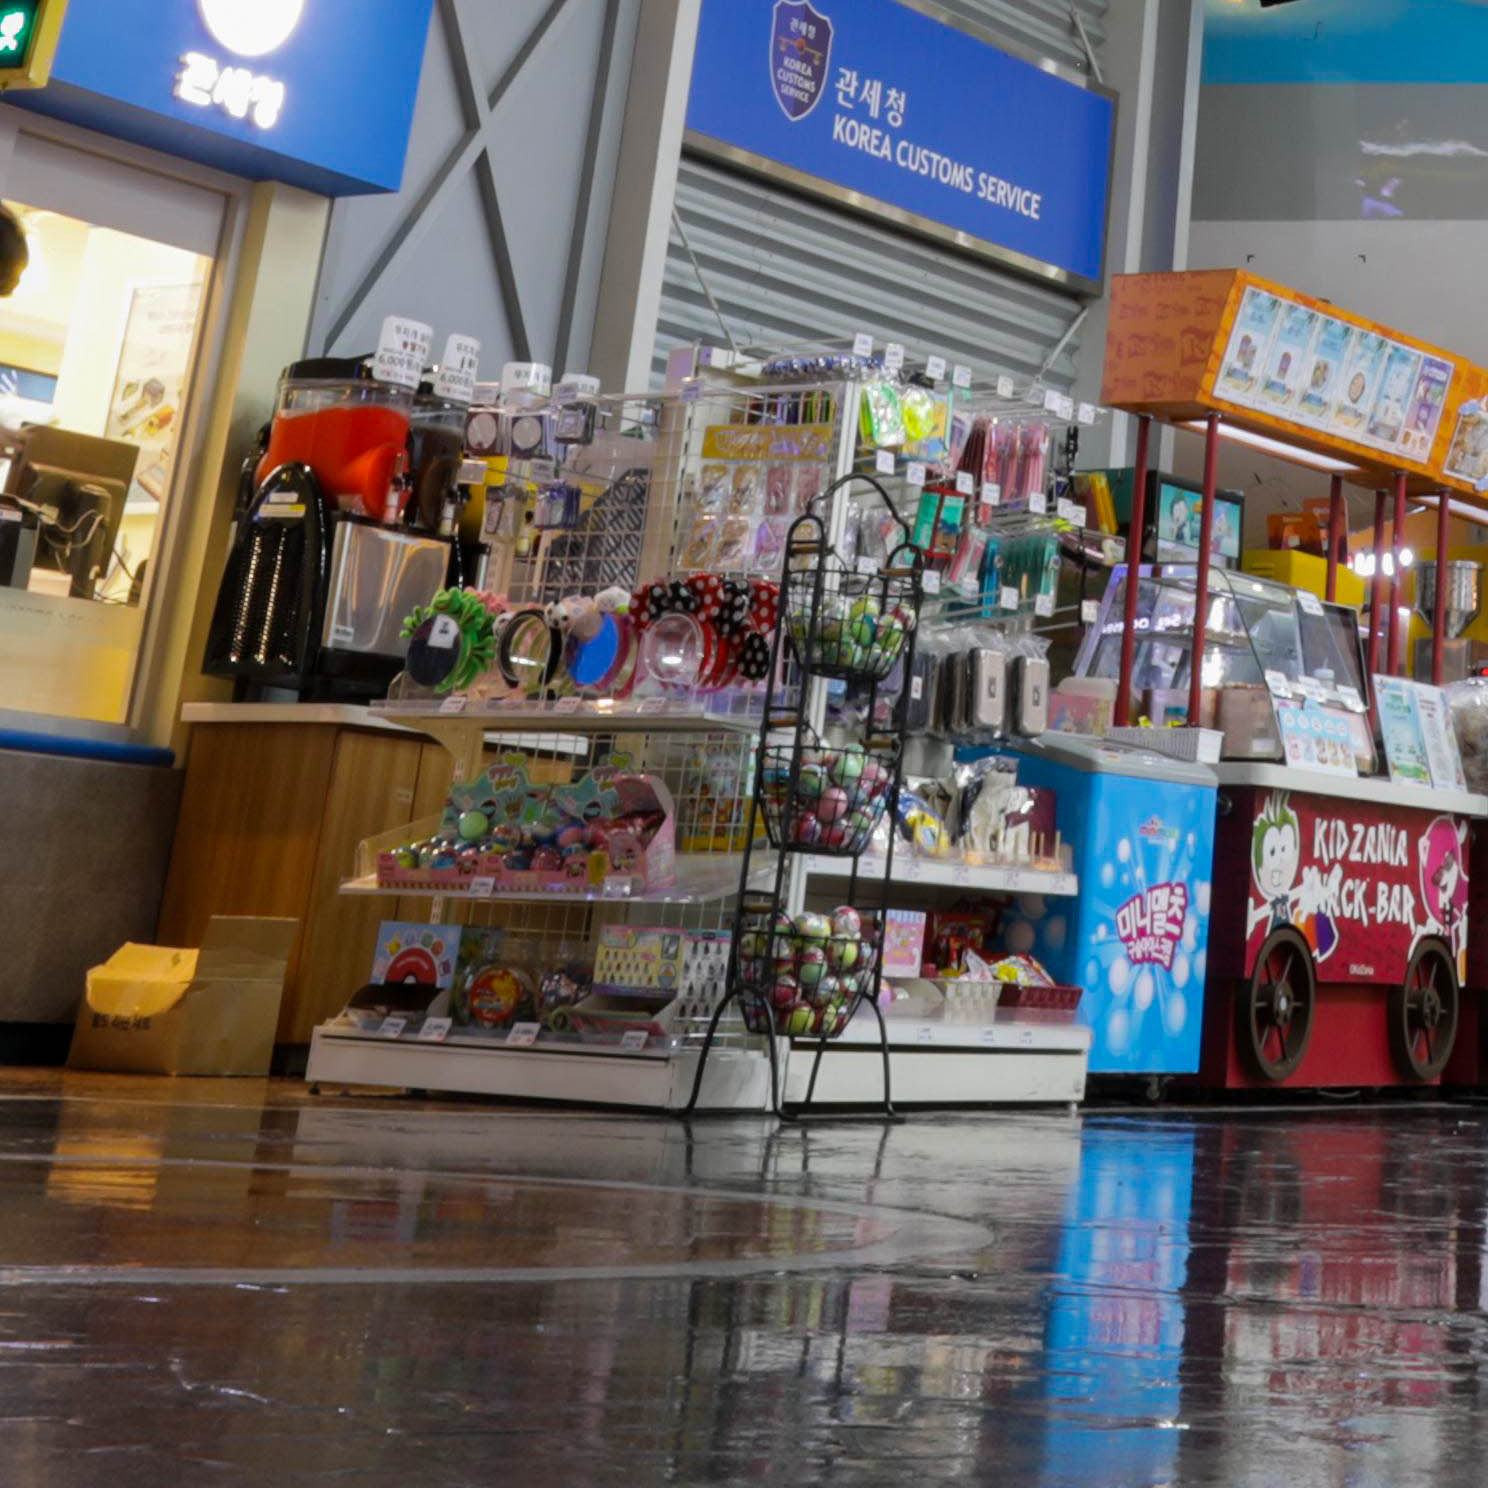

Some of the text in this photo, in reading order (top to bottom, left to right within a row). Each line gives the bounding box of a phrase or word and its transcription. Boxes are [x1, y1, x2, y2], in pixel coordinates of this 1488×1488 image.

[777, 67, 816, 93] CUSTOMS
[783, 56, 812, 77] KOREA
[780, 83, 809, 104] SERVICE
[835, 67, 907, 128] 관세청
[833, 114, 1042, 221] KOREA CUSTOMS SERVICE
[1314, 817, 1408, 867] KIDZANIA
